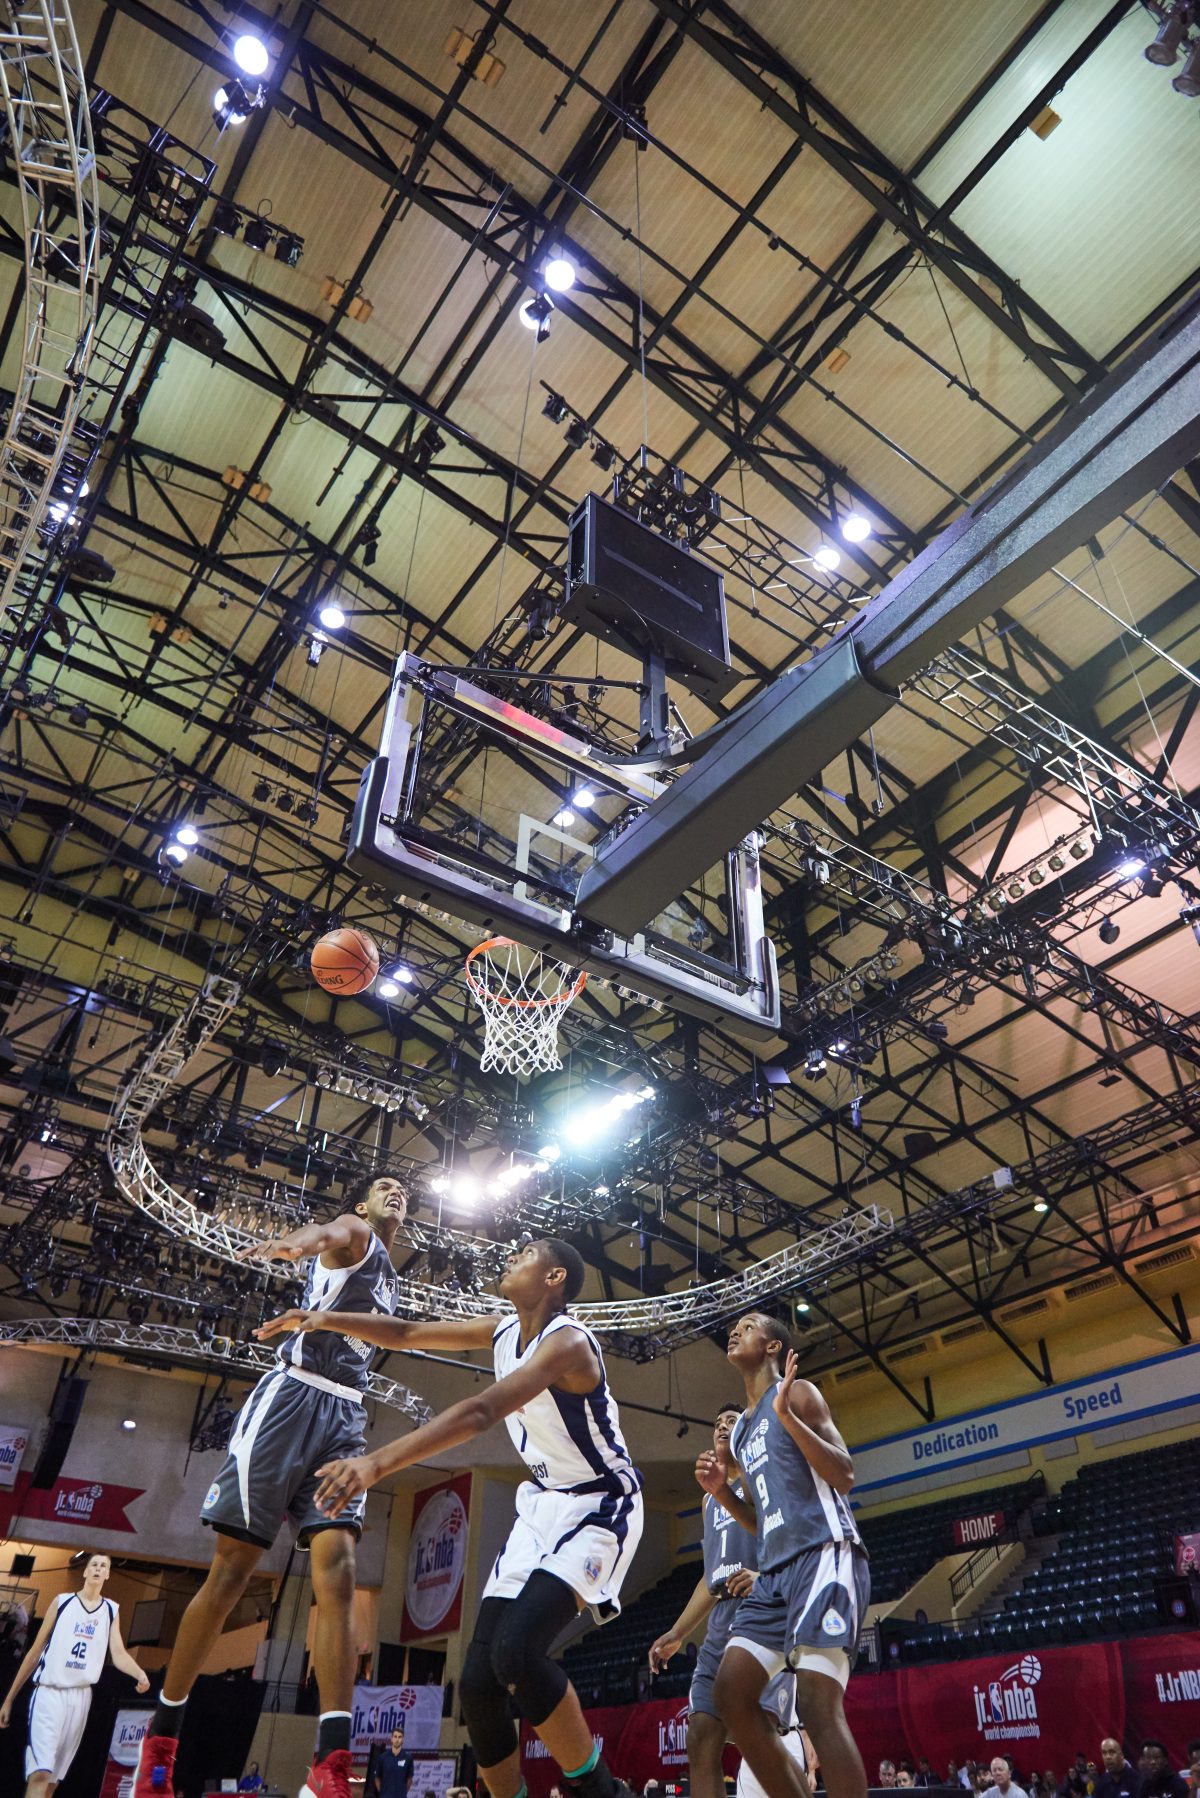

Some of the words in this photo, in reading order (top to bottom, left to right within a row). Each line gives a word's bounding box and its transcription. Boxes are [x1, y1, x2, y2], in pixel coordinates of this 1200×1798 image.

[1064, 1383, 1123, 1419] Speed
[912, 1423, 999, 1460] Dedication
[54, 1490, 67, 1511] jr.
[74, 1493, 95, 1512] nba
[755, 1473, 770, 1510] 9
[721, 1529, 728, 1558] 1
[960, 1514, 997, 1543] HOME
[414, 1541, 425, 1584] jr.
[434, 1533, 454, 1571] nba
[71, 1641, 87, 1659] 42
[1155, 1669, 1200, 1702] #JrNB
[352, 1705, 365, 1739] jr.
[379, 1706, 406, 1734] nba
[974, 1685, 992, 1732] jr.
[1004, 1681, 1038, 1721] nba
[119, 1725, 128, 1744] jr.
[135, 1725, 147, 1741] nb
[658, 1721, 668, 1758] jr.
[677, 1718, 689, 1750] nb
[984, 1725, 1000, 1741] world
[1000, 1722, 1041, 1740] championship
